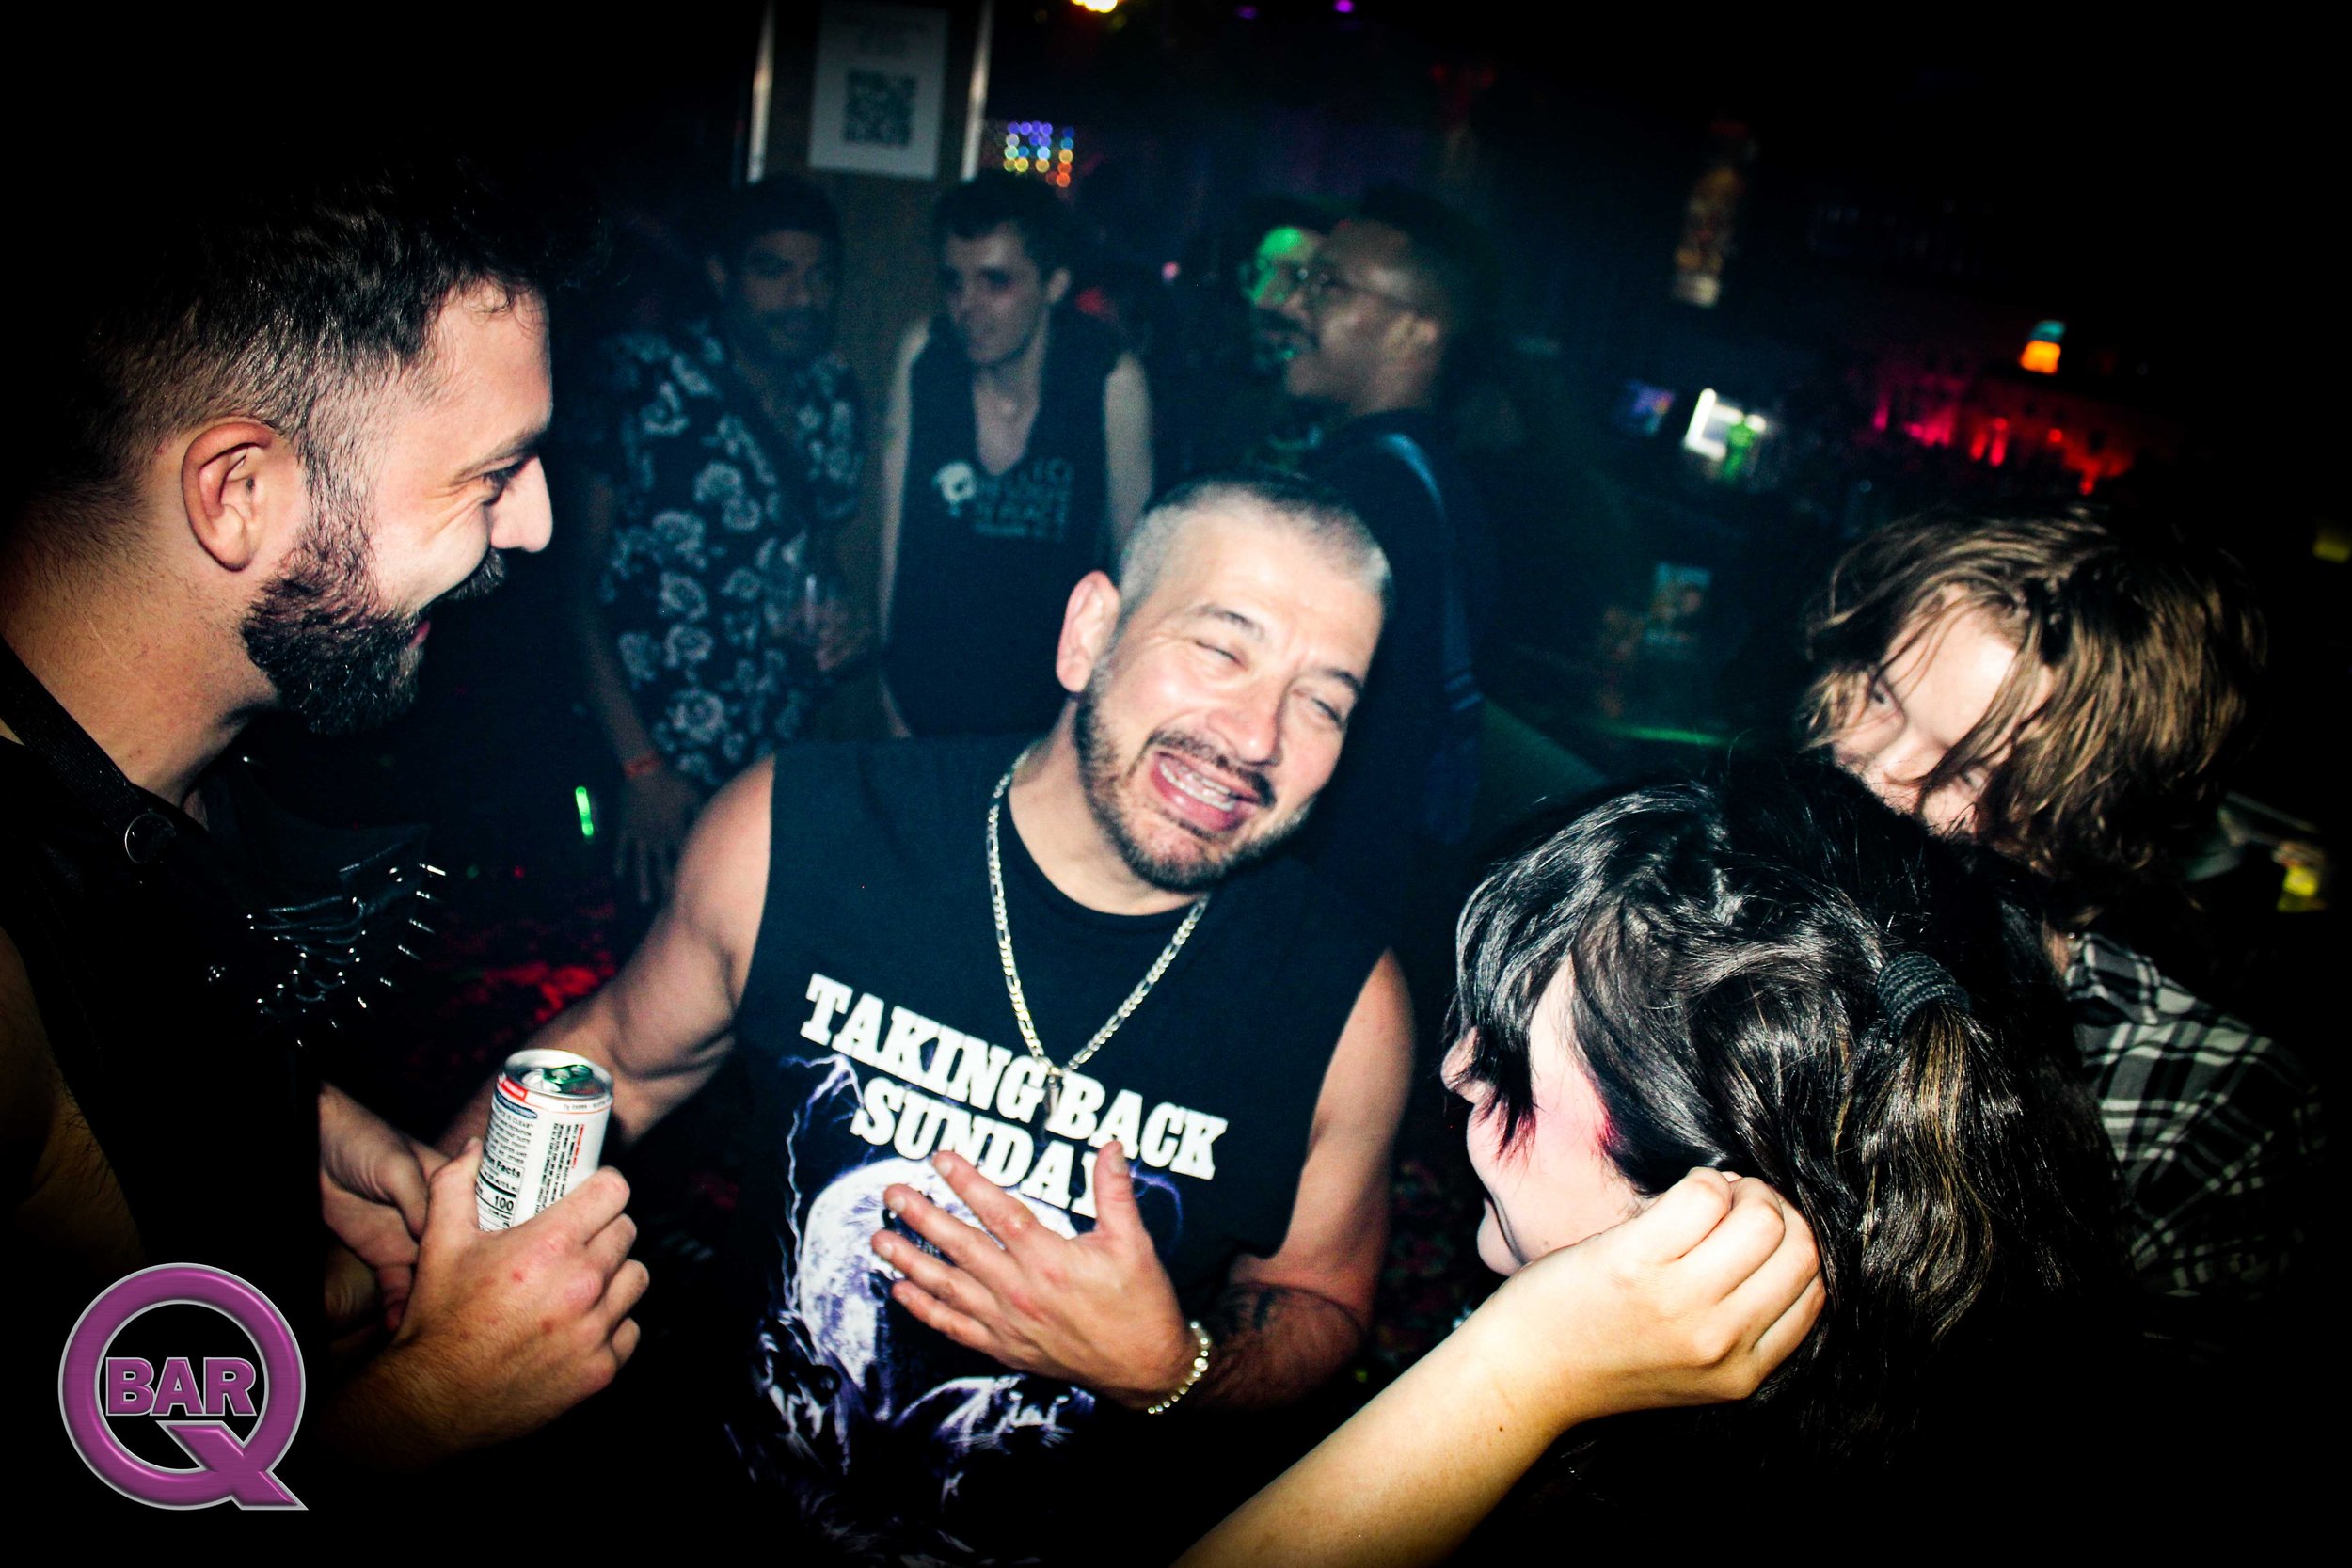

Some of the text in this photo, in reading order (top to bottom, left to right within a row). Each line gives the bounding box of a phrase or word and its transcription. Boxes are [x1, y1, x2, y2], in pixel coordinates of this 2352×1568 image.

[800, 973, 1229, 1181] TAKING BACK
[496, 1160, 522, 1179] Facts
[494, 1195, 515, 1212] 100
